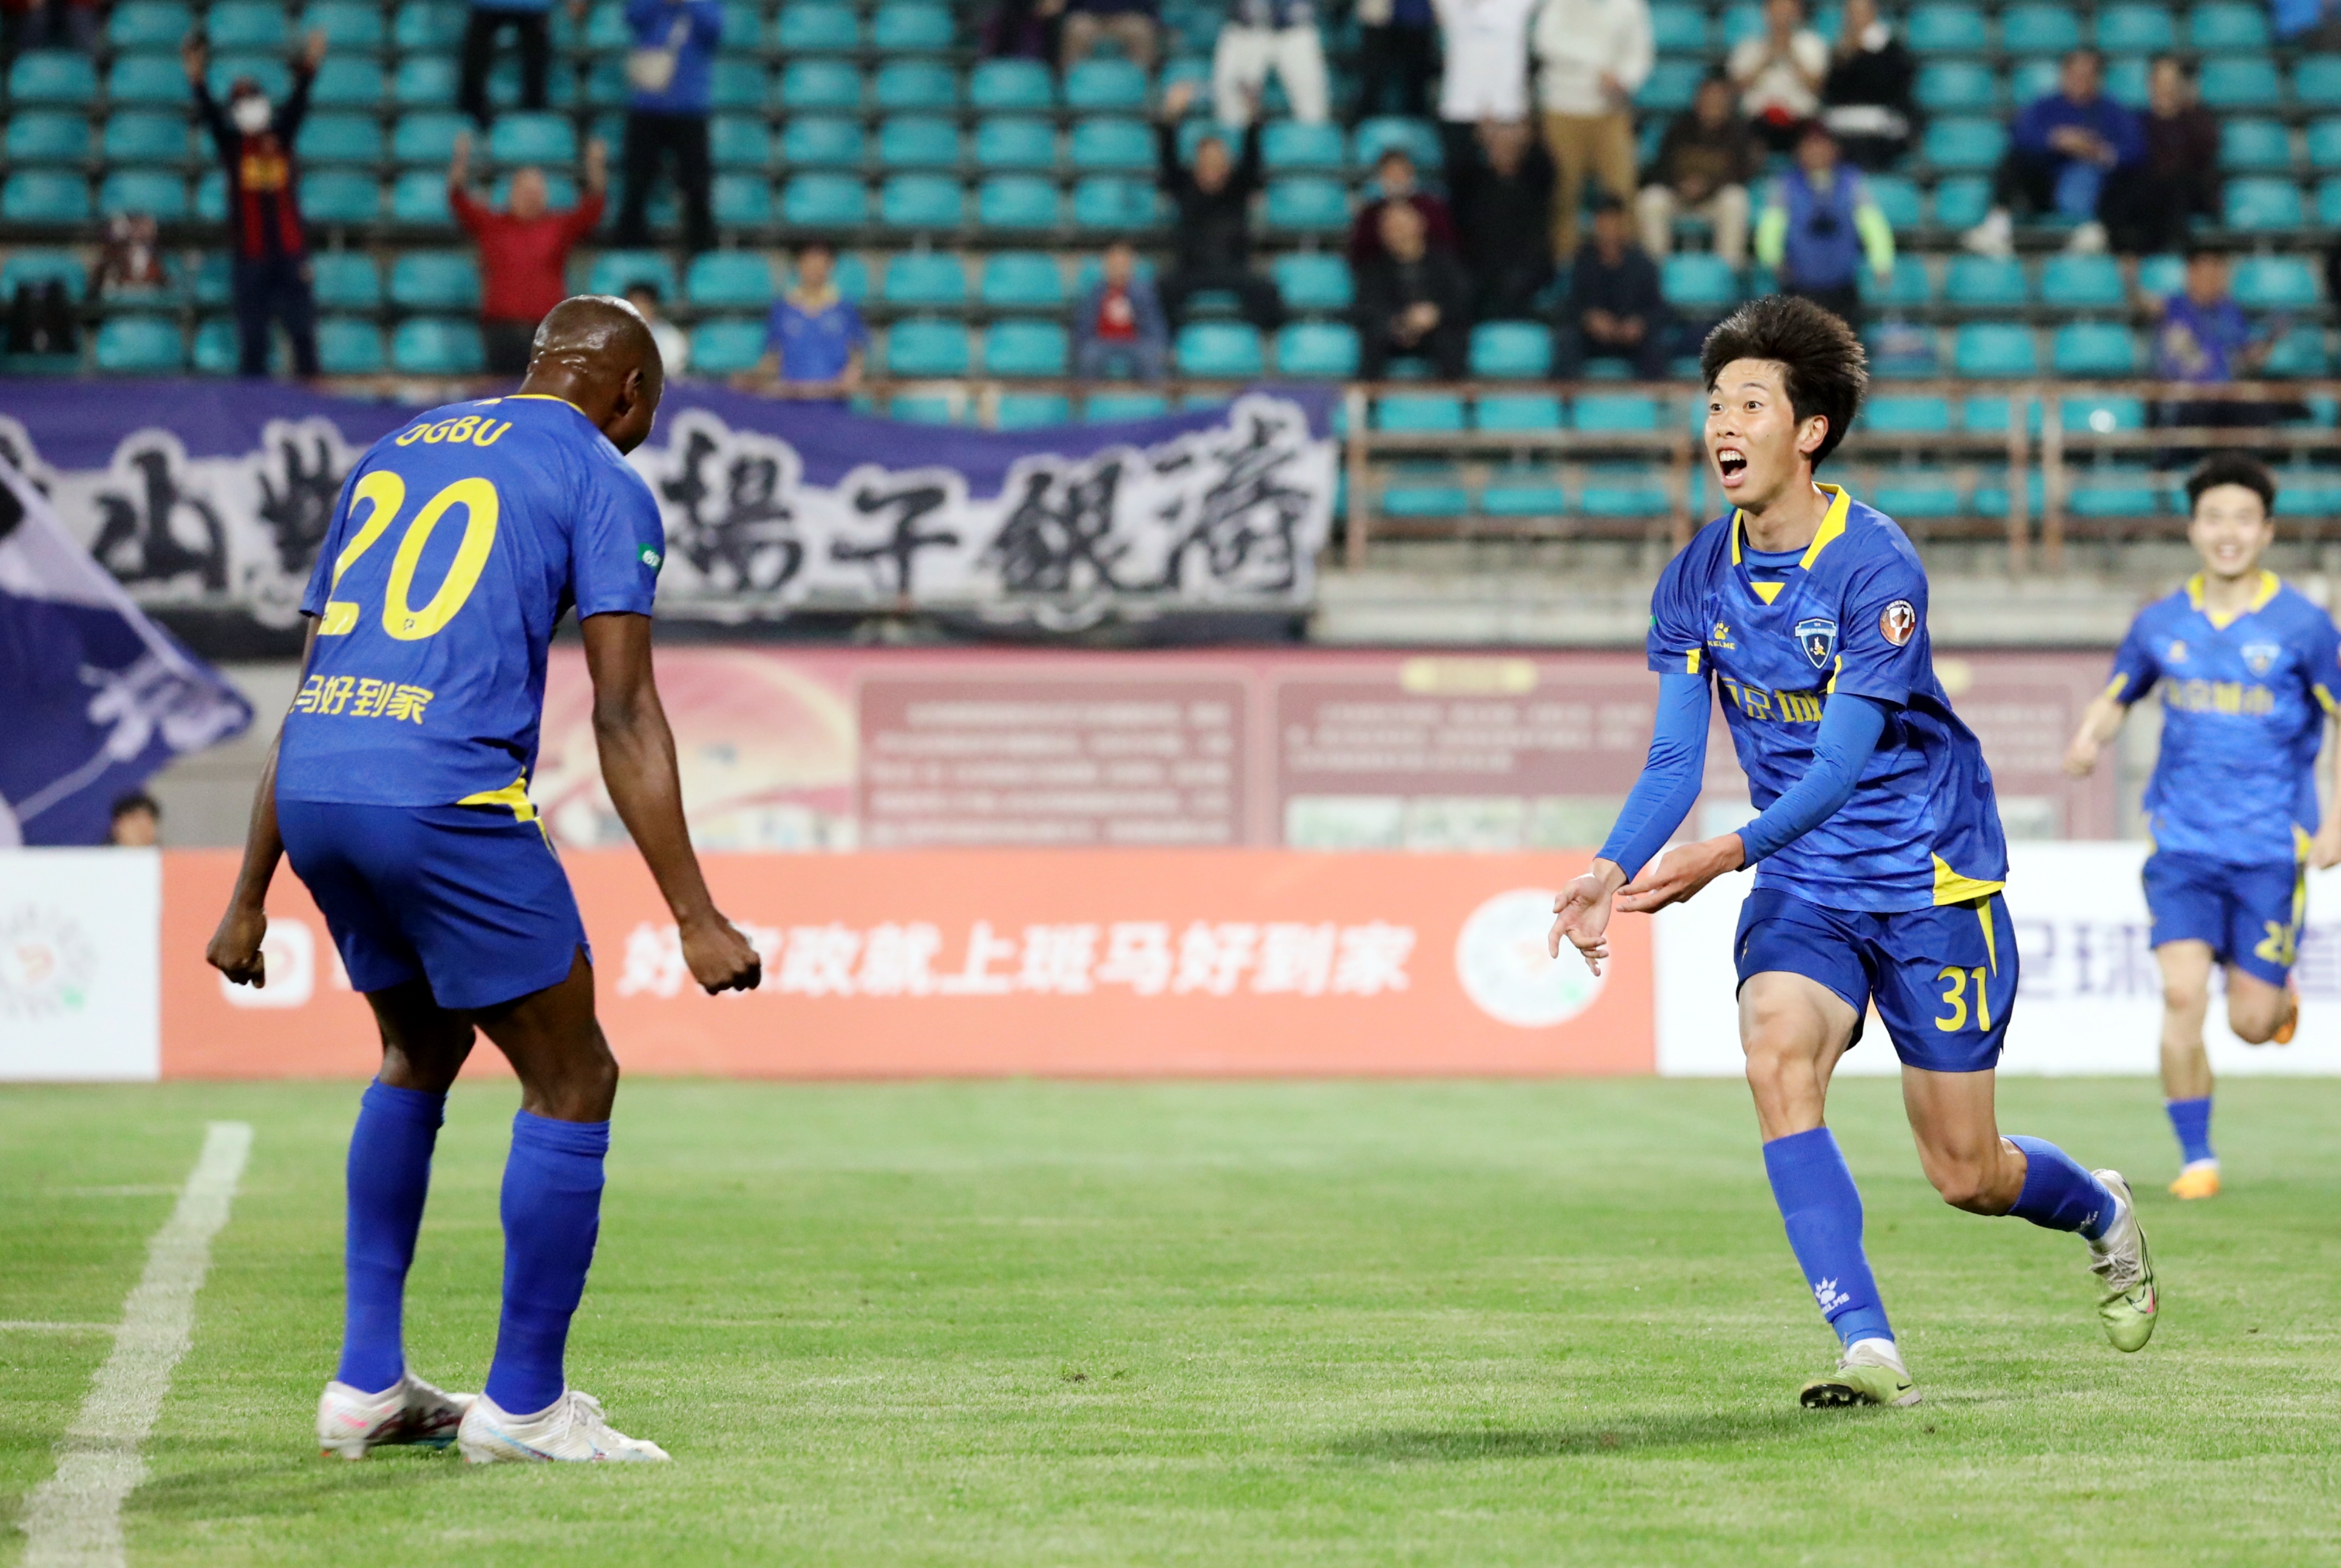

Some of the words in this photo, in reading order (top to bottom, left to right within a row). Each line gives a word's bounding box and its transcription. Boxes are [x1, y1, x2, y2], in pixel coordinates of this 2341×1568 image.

[395, 415, 513, 446] OGBU
[317, 470, 499, 641] 20
[1707, 640, 1736, 650] KELME
[617, 919, 1415, 998] 好政就上斑马好到家
[1935, 966, 1990, 1032] 31
